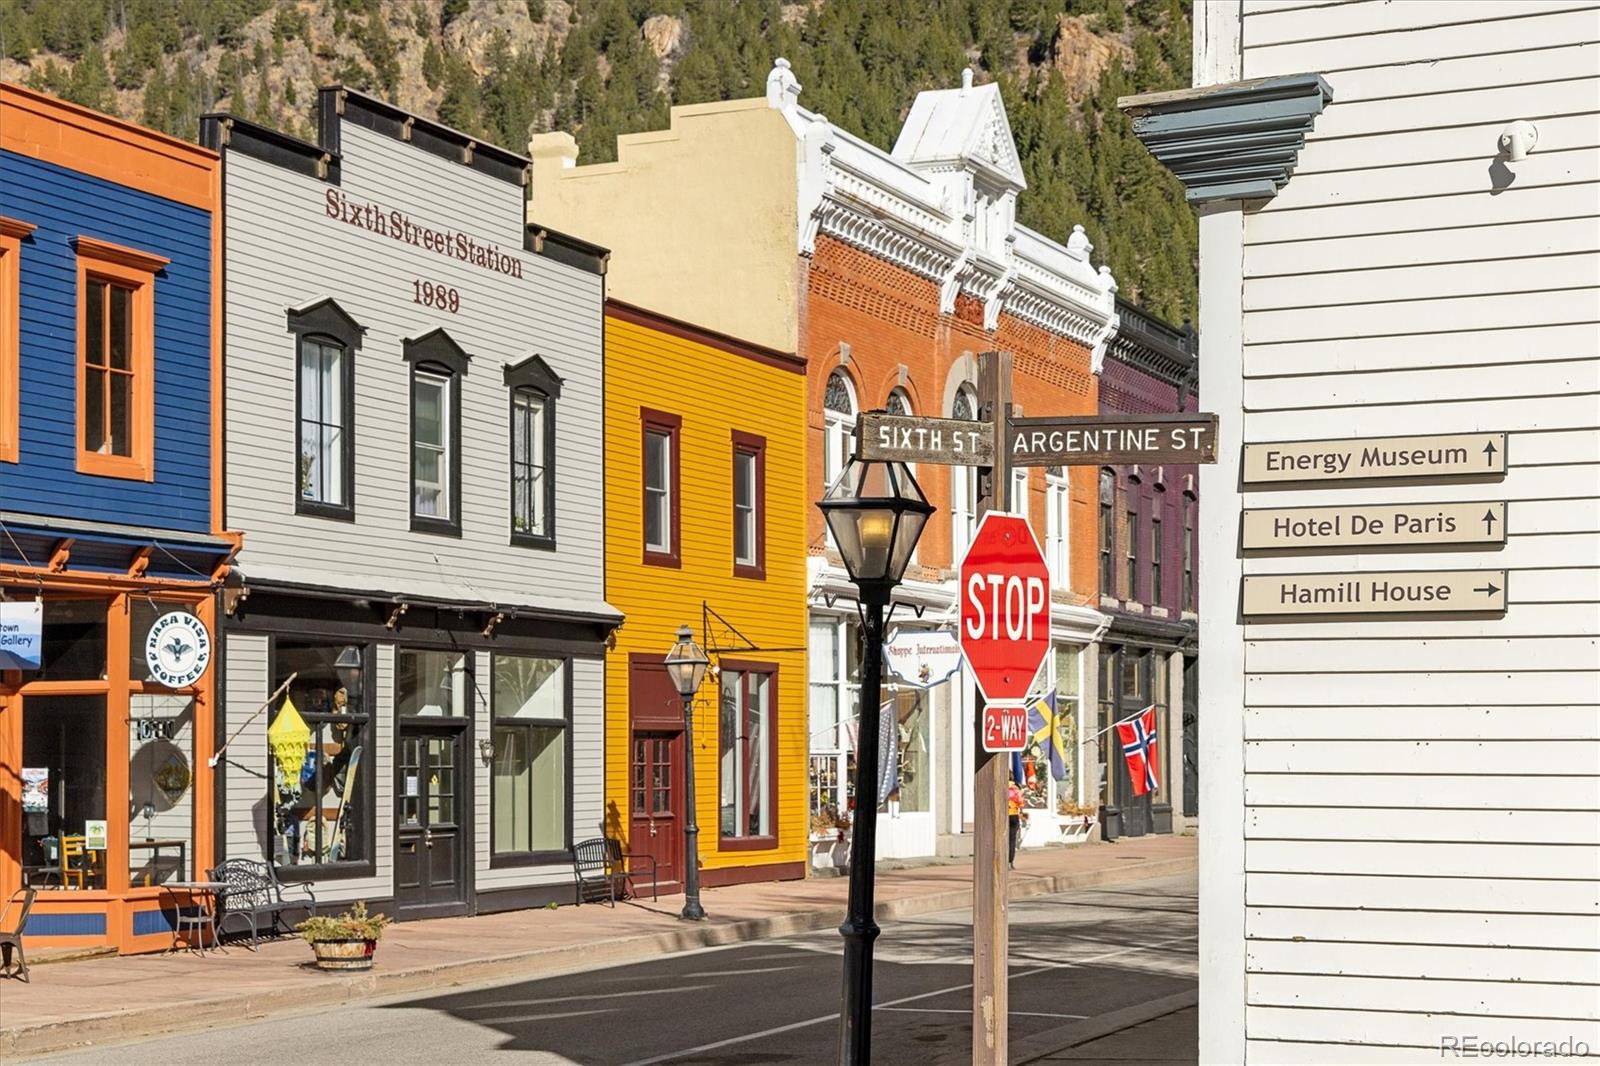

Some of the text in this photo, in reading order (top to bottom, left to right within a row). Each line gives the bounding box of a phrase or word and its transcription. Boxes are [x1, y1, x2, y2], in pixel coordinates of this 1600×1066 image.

[326, 188, 523, 279] Sixth Street Station
[413, 279, 460, 314] 1989
[879, 425, 980, 453] SIXTH ST
[1013, 427, 1212, 453] ARGENTINE ST.
[1266, 447, 1468, 473] Energy Museum
[1274, 513, 1457, 538] Hotel De Paris
[1280, 582, 1452, 604] Hamill House
[966, 572, 1045, 641] STOP
[1, 635, 33, 648] Gallery
[153, 664, 203, 684] COFFEE
[987, 714, 1025, 741] 2-WAY
